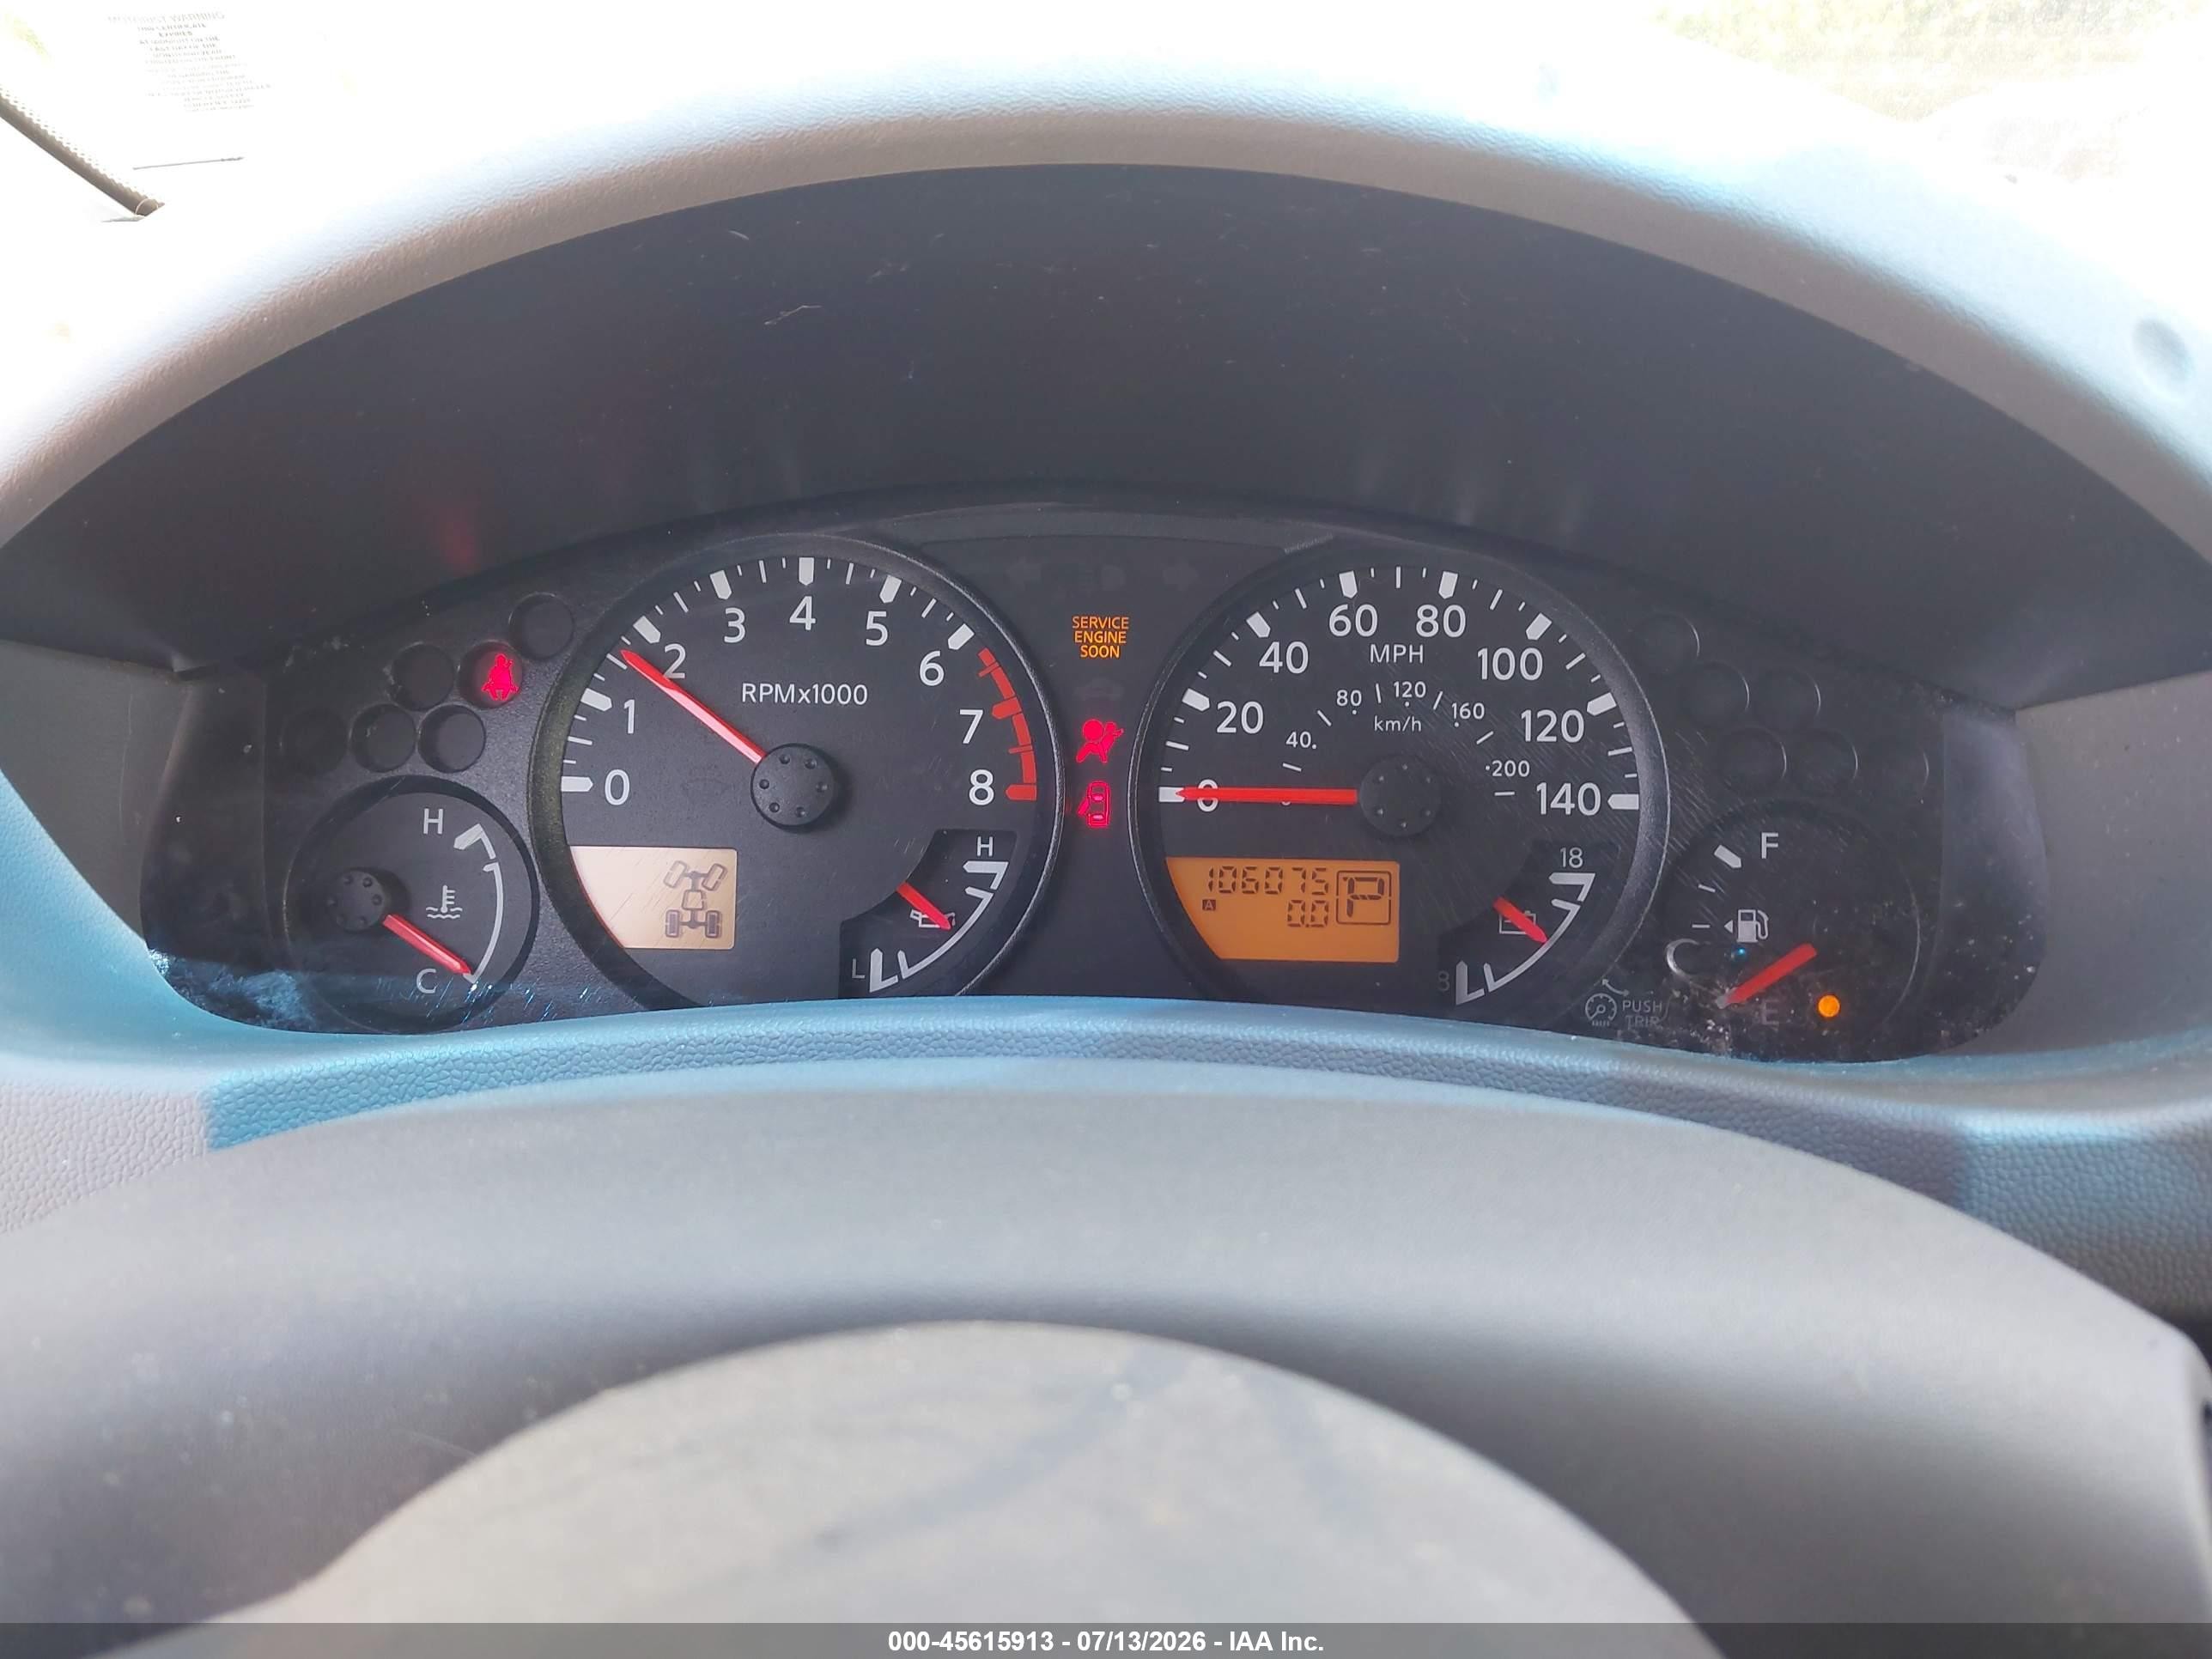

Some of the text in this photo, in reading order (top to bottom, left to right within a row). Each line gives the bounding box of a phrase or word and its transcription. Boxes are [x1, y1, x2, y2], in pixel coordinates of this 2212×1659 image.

[725, 608, 745, 642] 3
[790, 596, 816, 630] 4
[1073, 617, 1129, 629] SERVICE
[1329, 605, 1377, 636] 60
[1417, 605, 1465, 637] 80
[866, 611, 887, 646] 5
[1075, 631, 1127, 644] ENGINE
[661, 645, 685, 679] 2
[1080, 645, 1121, 659] SOON
[1260, 641, 1308, 673] 40
[1370, 644, 1423, 663] MPH
[1478, 648, 1542, 680] 100
[920, 651, 944, 685] 6
[743, 684, 867, 704] RPMx1000
[1337, 690, 1361, 706] 80
[1395, 682, 1425, 697] 120
[624, 700, 635, 733] 1
[1217, 702, 1263, 733] 20
[1375, 716, 1421, 731] km/h
[1452, 703, 1484, 719] 160
[960, 709, 982, 744] 7
[1285, 732, 1307, 747] 40
[1522, 709, 1585, 742] 120
[1492, 760, 1529, 776] 200
[605, 769, 629, 805] 0
[969, 769, 994, 805] 8
[1537, 783, 1601, 815] 140
[423, 809, 443, 834] H
[977, 837, 993, 856] H
[1561, 848, 1583, 868] 18
[1762, 833, 1778, 859] F
[1208, 866, 1329, 896] 106075
[1343, 877, 1385, 918] P
[1288, 899, 1329, 928] 0.0
[416, 969, 437, 994] C
[852, 959, 865, 979] L
[1622, 1000, 1662, 1012] PUSH
[1762, 999, 1780, 1026] E
